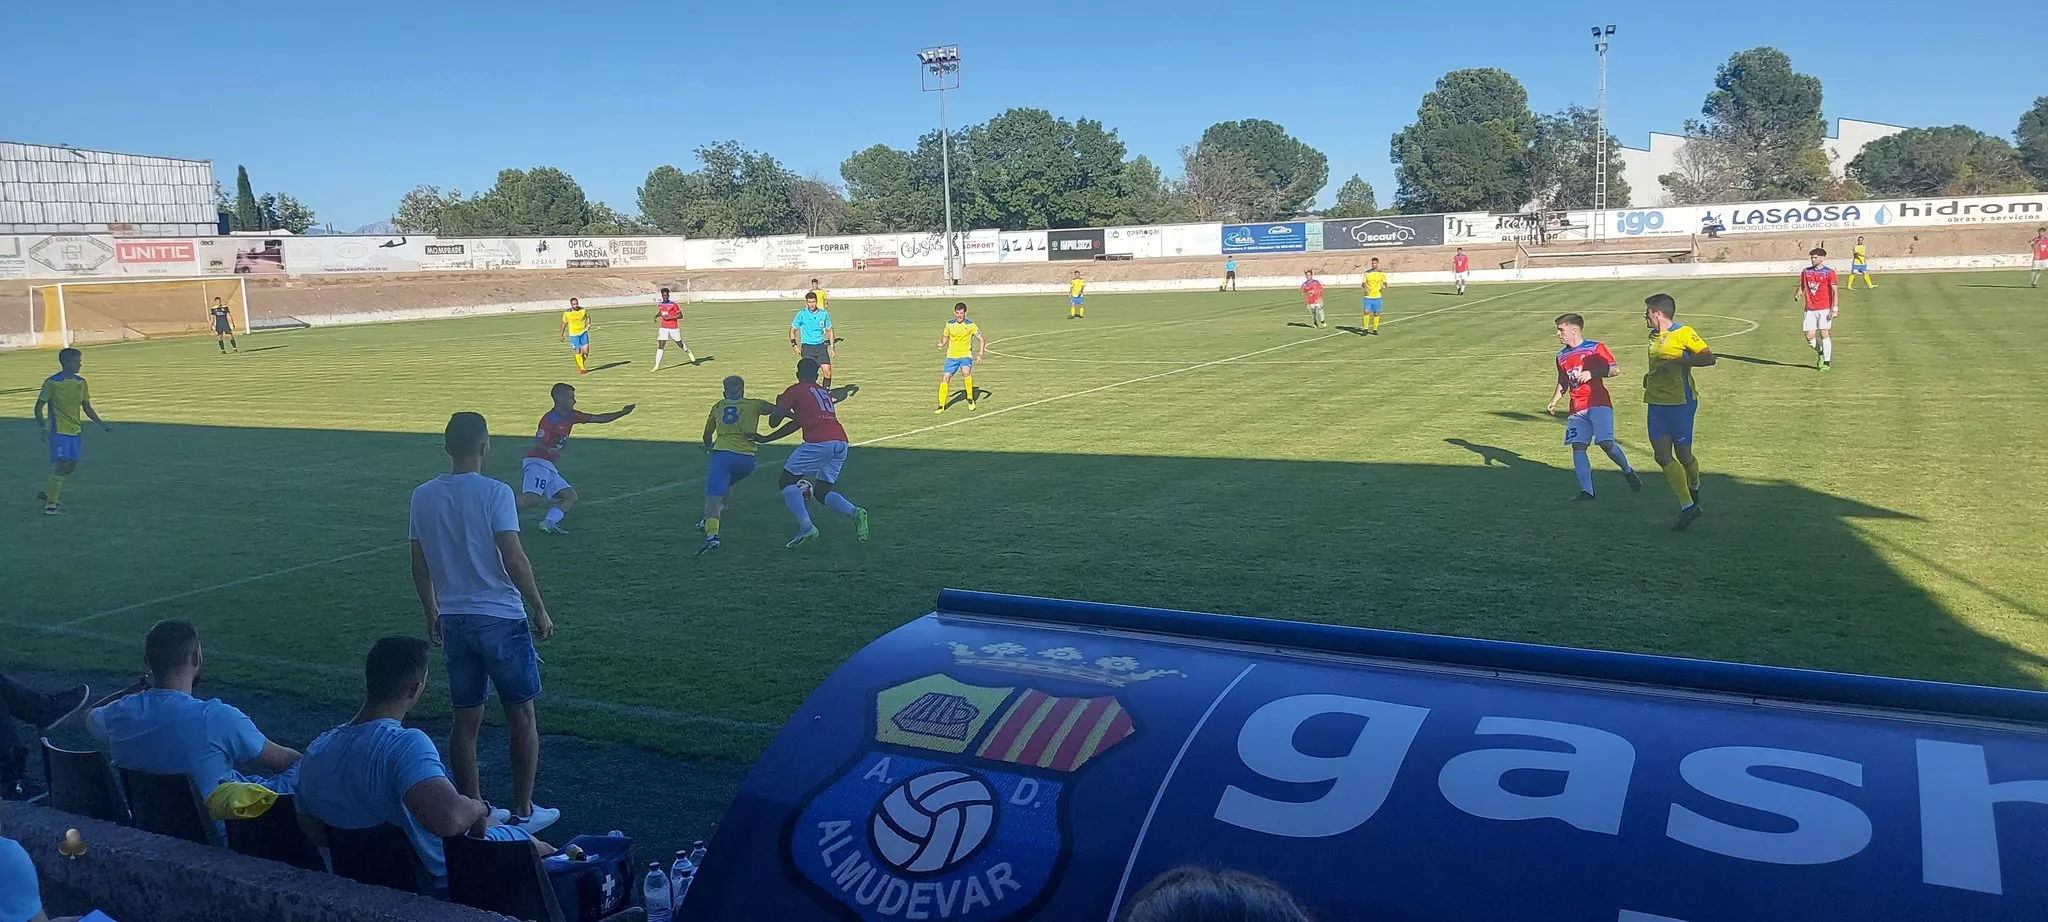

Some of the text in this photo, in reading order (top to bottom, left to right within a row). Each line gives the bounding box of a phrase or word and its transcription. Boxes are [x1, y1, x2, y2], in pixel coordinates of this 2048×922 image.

[1732, 205, 1861, 225] LASAOSA
[1899, 201, 2048, 217] hidrom
[1616, 211, 1664, 235] igo
[1947, 215, 1977, 223] obras
[1990, 213, 2041, 221] servicios
[1731, 223, 1789, 231] PRODUCTOS
[1501, 233, 1559, 242] ALMUDEAR
[121, 245, 190, 261] UNITIC
[820, 243, 851, 252] FOPRAR
[722, 405, 738, 425] 8
[534, 477, 547, 490] 18
[817, 818, 1022, 921] ALMUDEVAR
